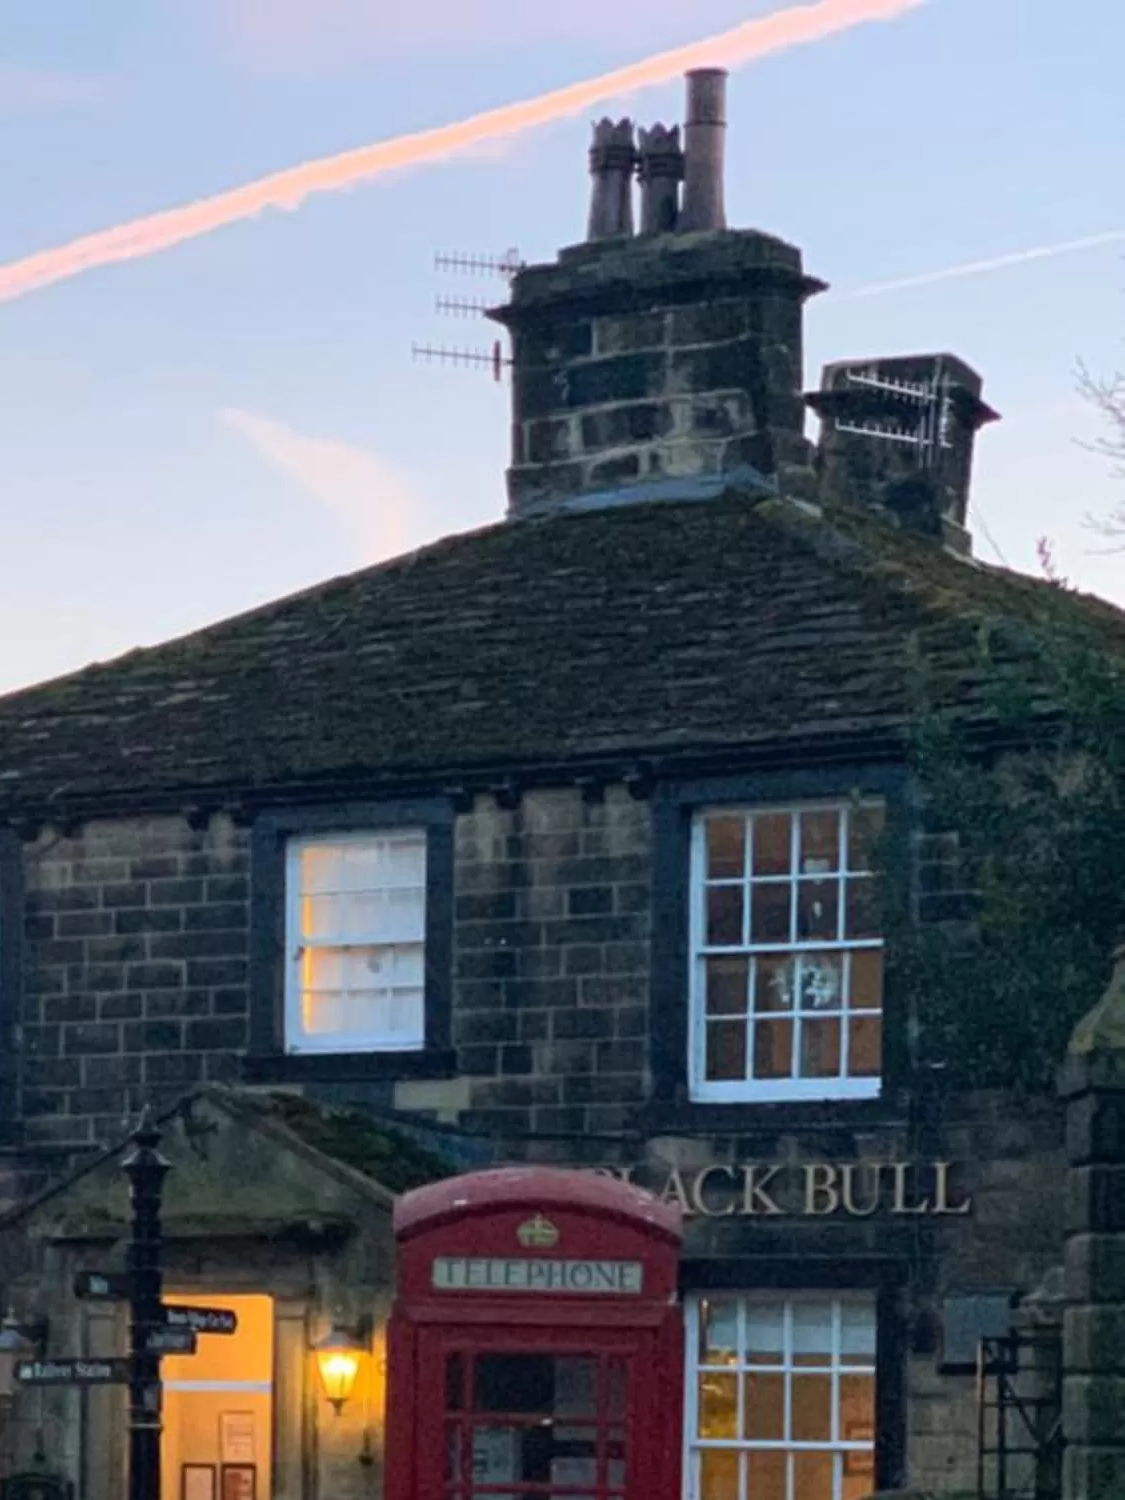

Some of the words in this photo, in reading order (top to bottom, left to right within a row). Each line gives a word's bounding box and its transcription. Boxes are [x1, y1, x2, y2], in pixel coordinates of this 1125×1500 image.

[592, 1163, 786, 1217] ACK
[802, 1160, 972, 1217] BULL
[442, 1259, 638, 1290] TELEPHONE
